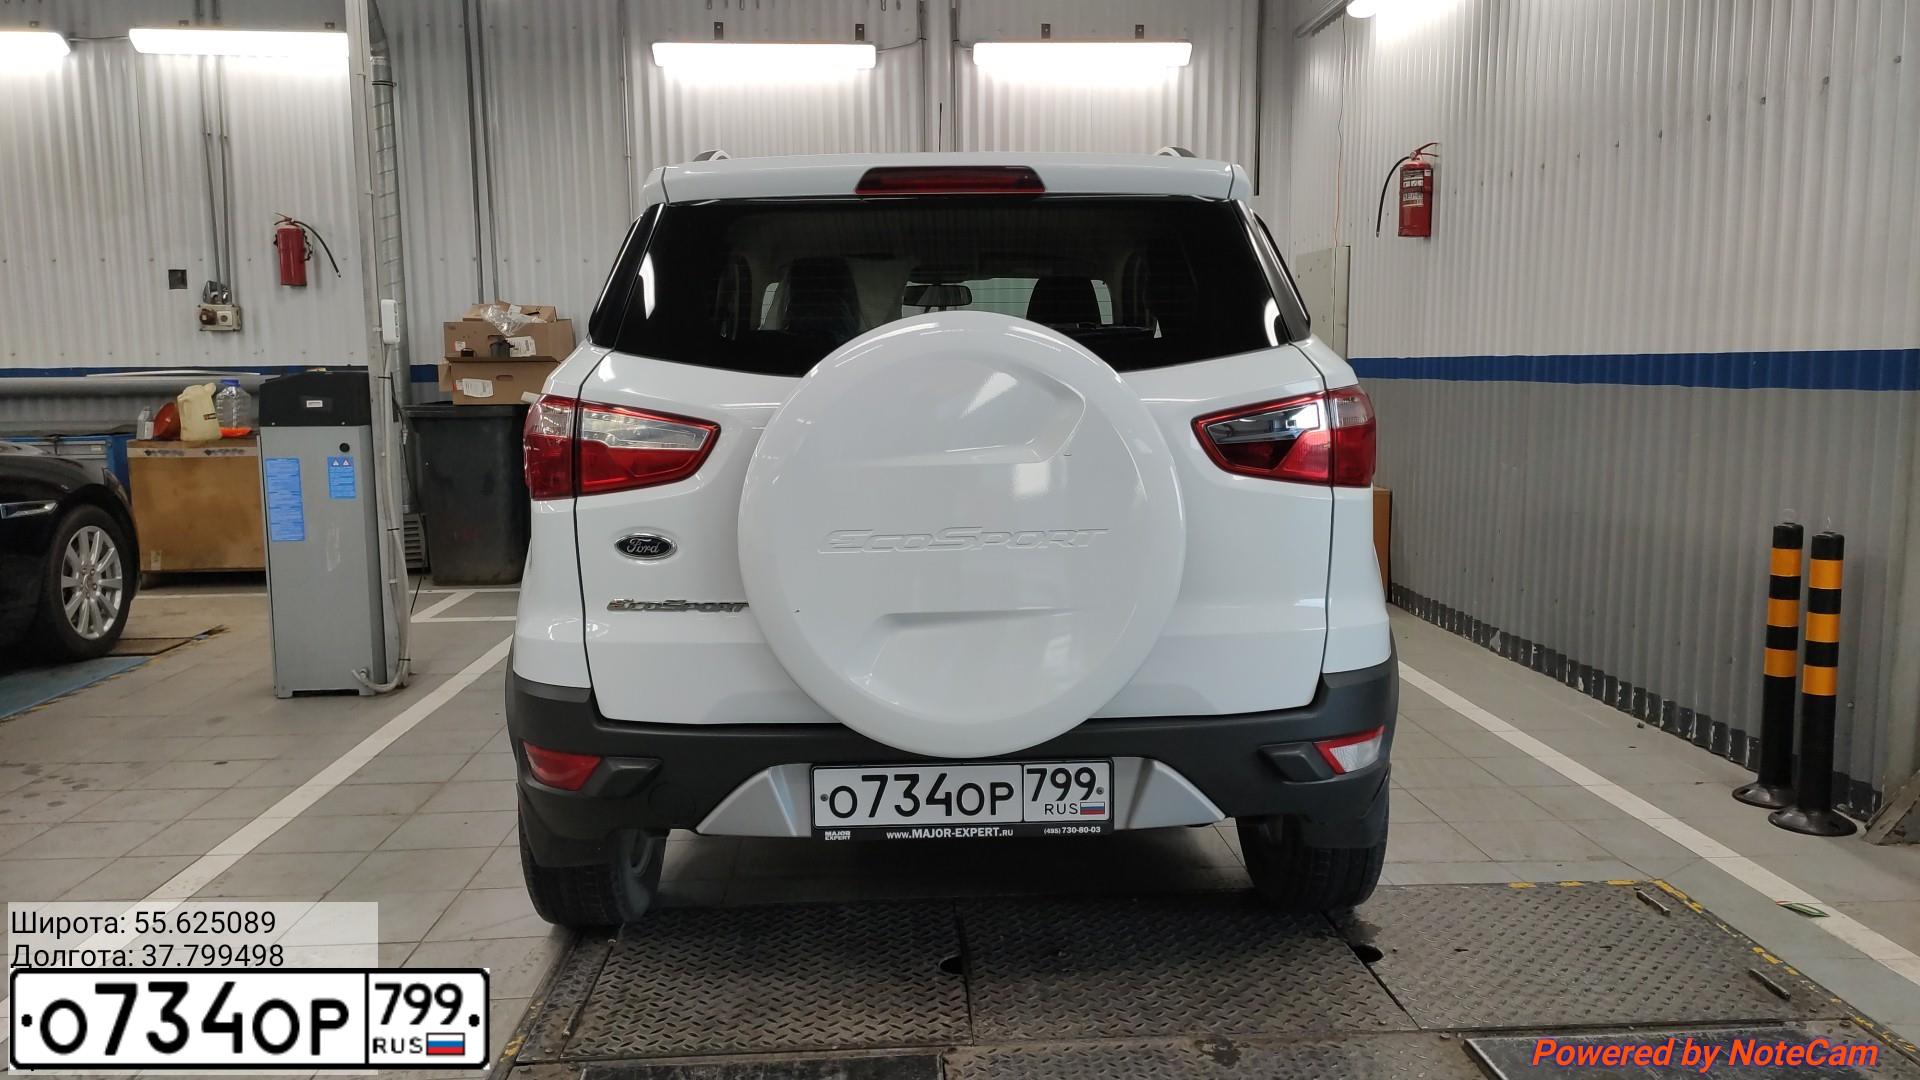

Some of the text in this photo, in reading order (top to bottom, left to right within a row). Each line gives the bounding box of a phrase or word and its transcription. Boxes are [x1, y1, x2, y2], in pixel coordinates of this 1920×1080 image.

[626, 538, 660, 553] Ford
[1026, 766, 1097, 802] 799
[1044, 803, 1078, 815] RUS
